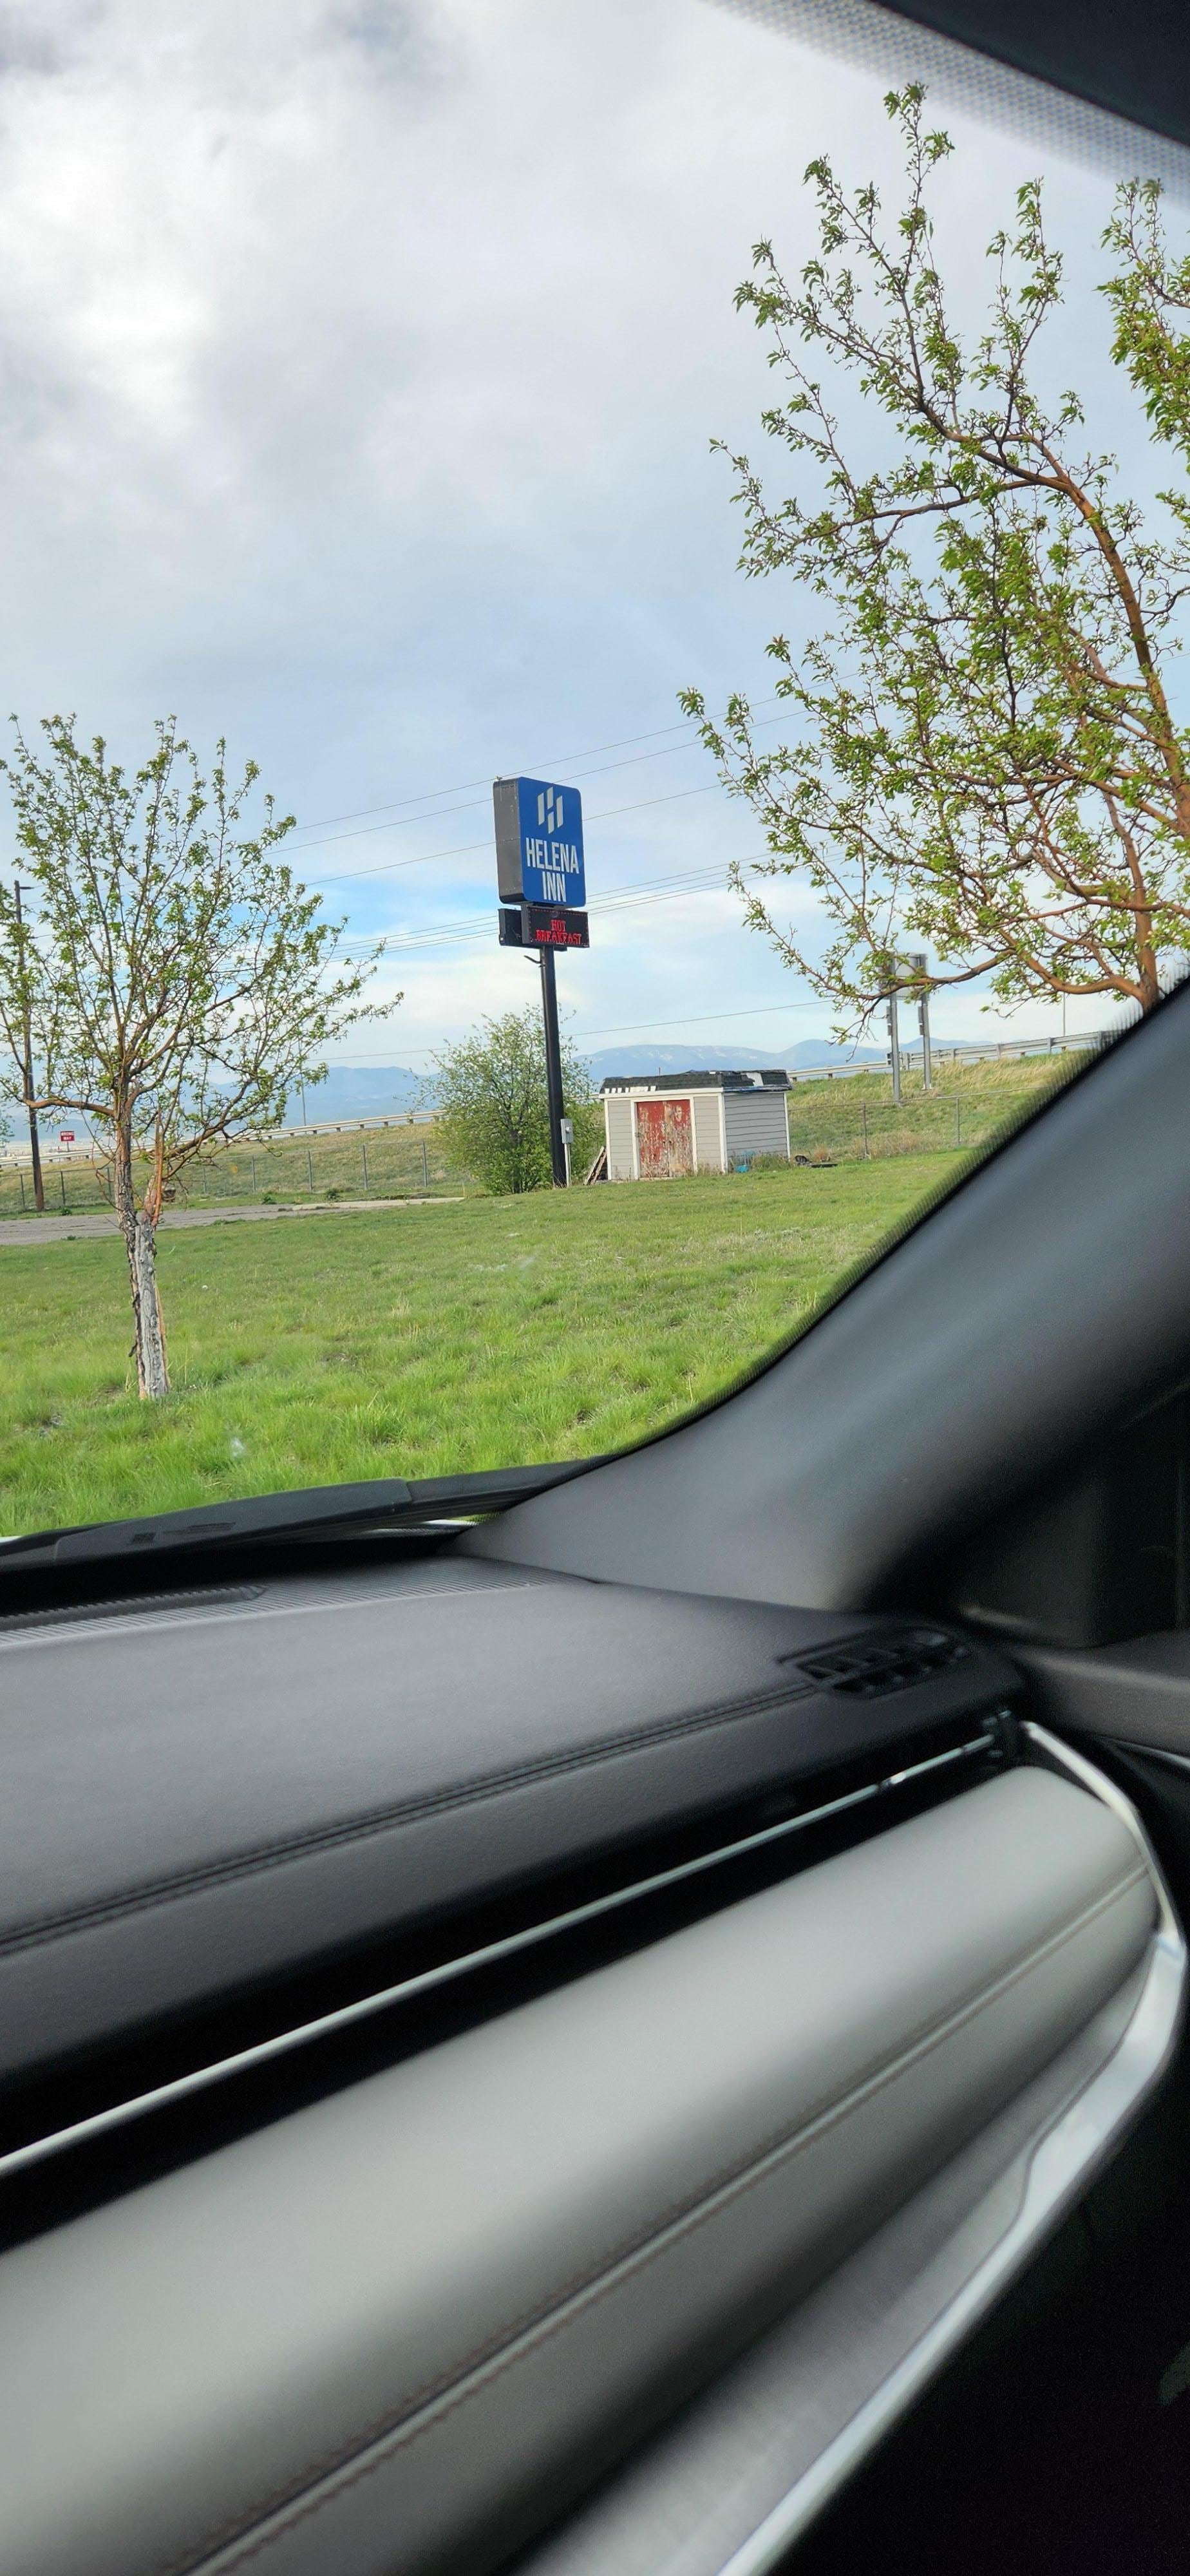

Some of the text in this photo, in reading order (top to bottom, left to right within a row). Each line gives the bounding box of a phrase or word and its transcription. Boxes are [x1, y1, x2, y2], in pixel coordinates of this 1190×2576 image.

[525, 837, 580, 874] HELENA
[543, 871, 567, 902] INN
[536, 929, 581, 945] BREAKFAST
[551, 919, 566, 932] HOT
